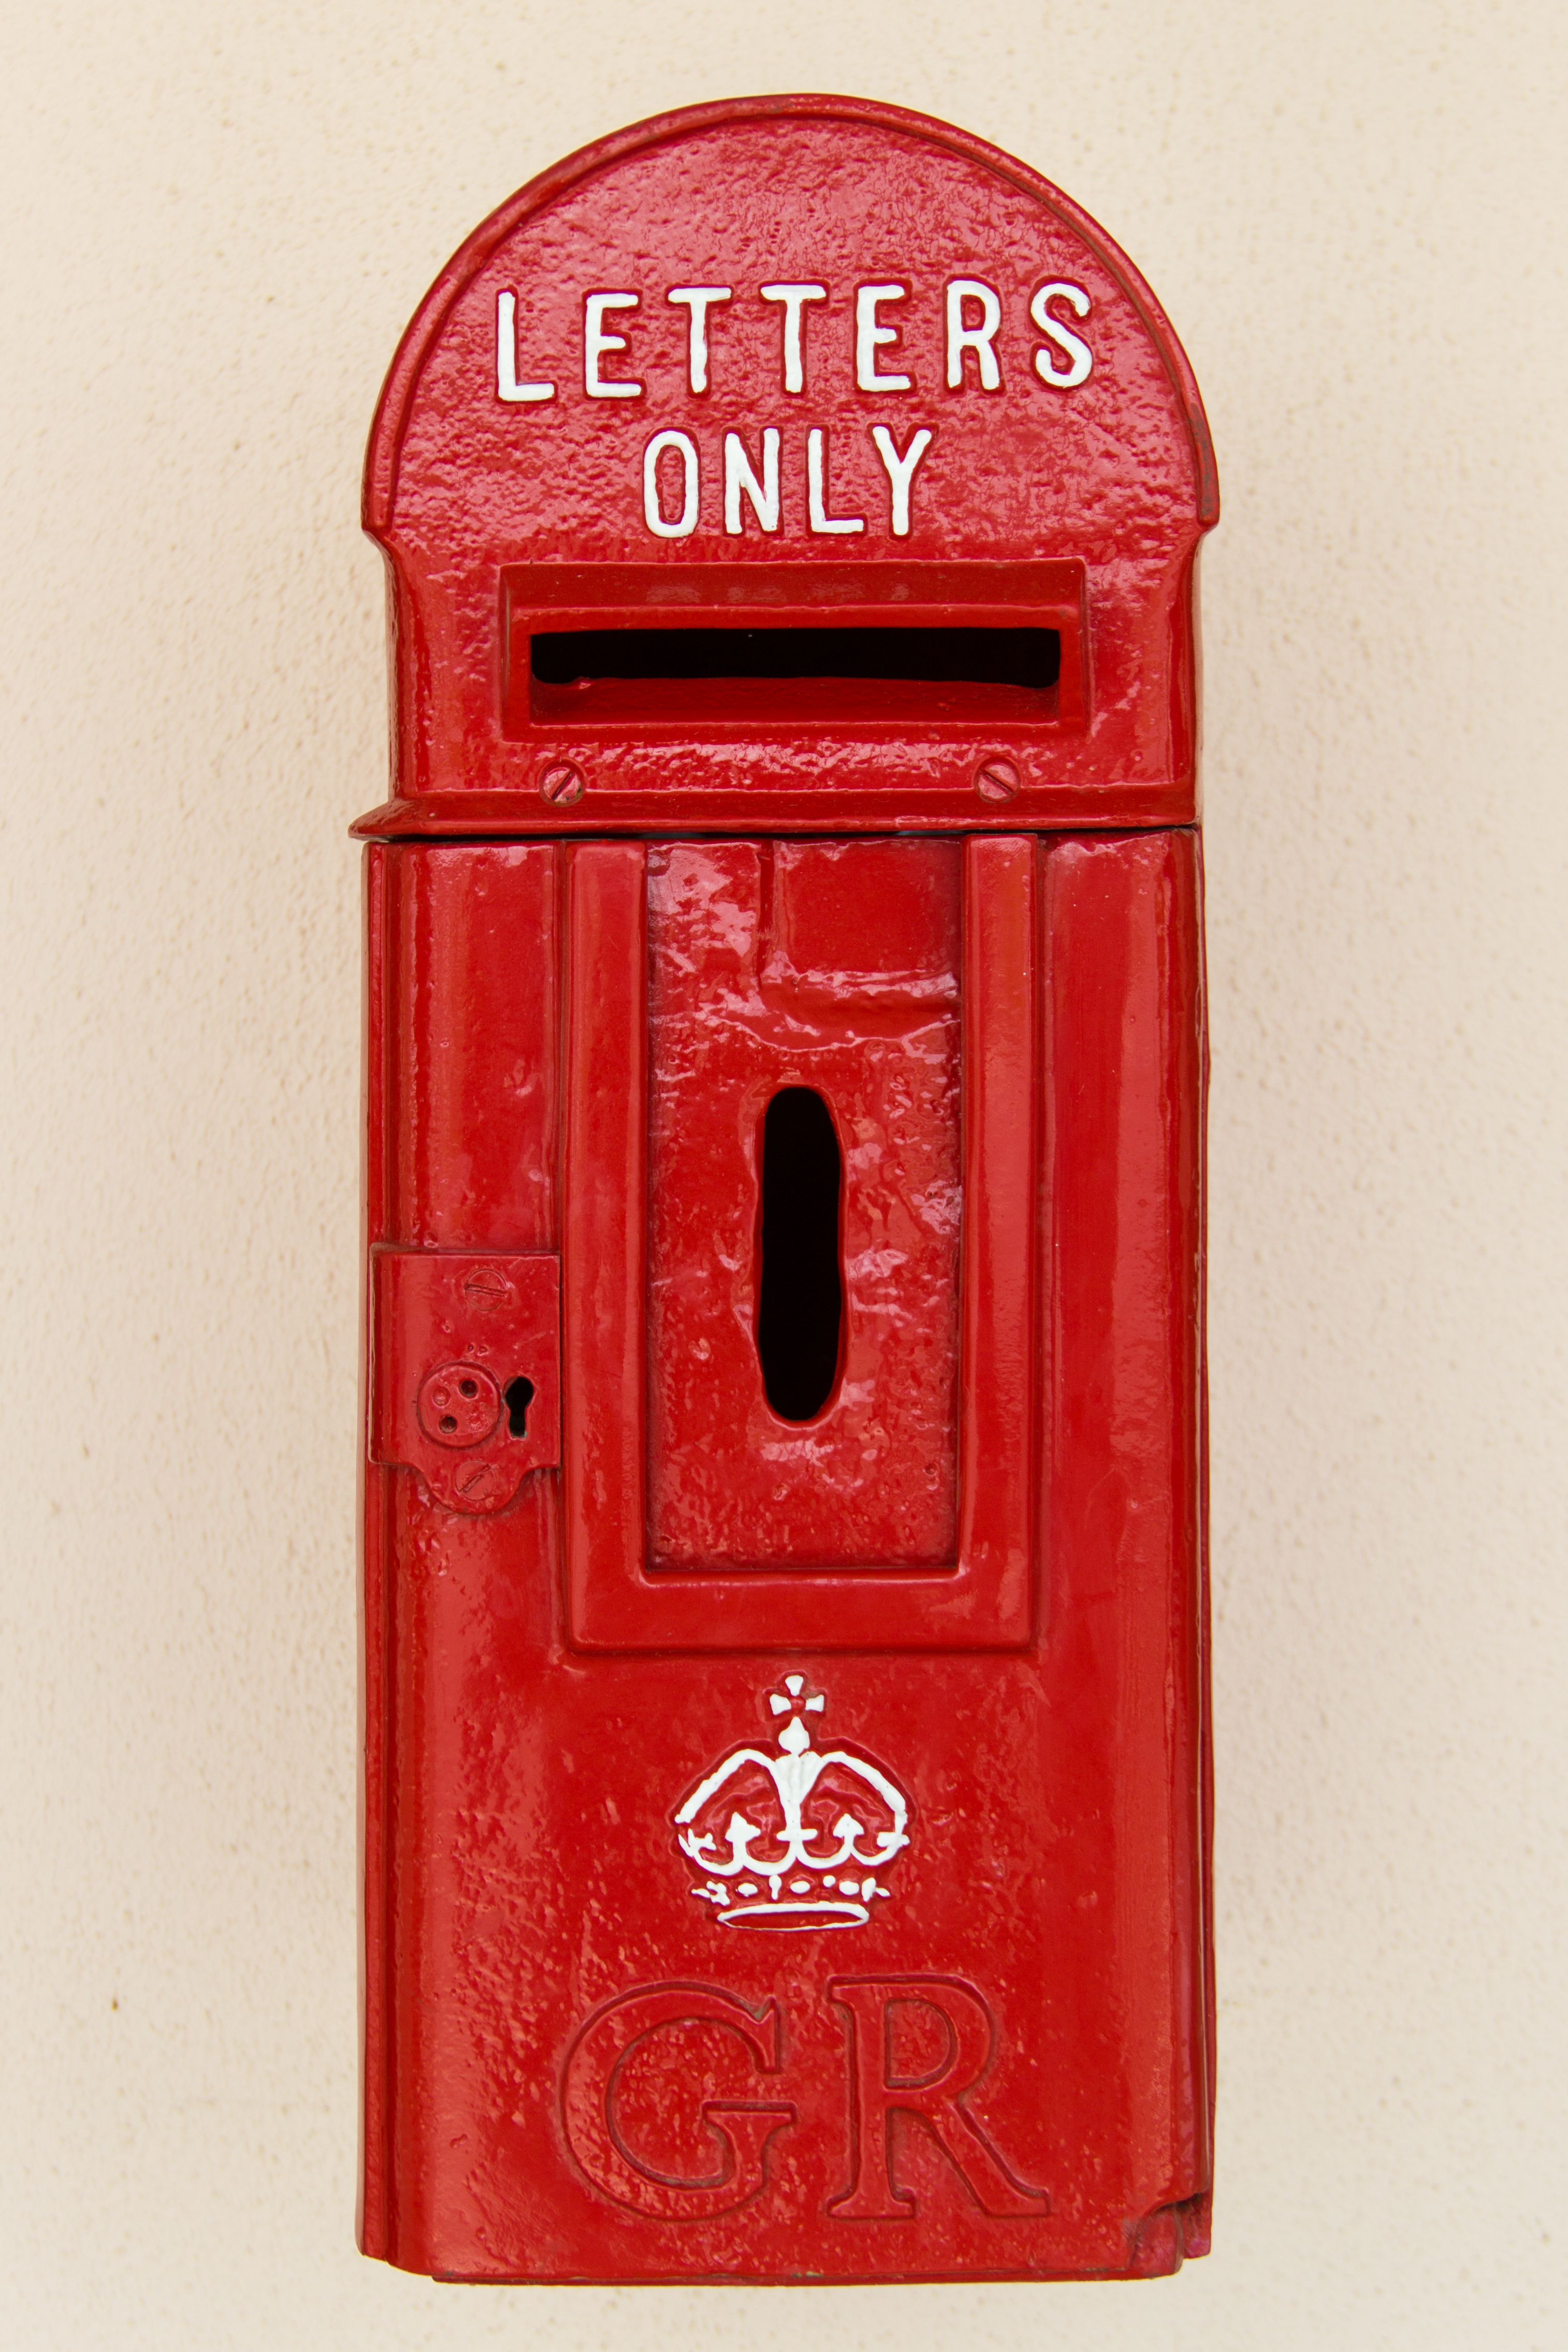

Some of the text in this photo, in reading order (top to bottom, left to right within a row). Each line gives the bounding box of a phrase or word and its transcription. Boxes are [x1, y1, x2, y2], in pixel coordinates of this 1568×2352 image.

[496, 280, 1093, 401] LETTERS
[643, 426, 933, 538] ONLY
[562, 1974, 1051, 2220] GR
